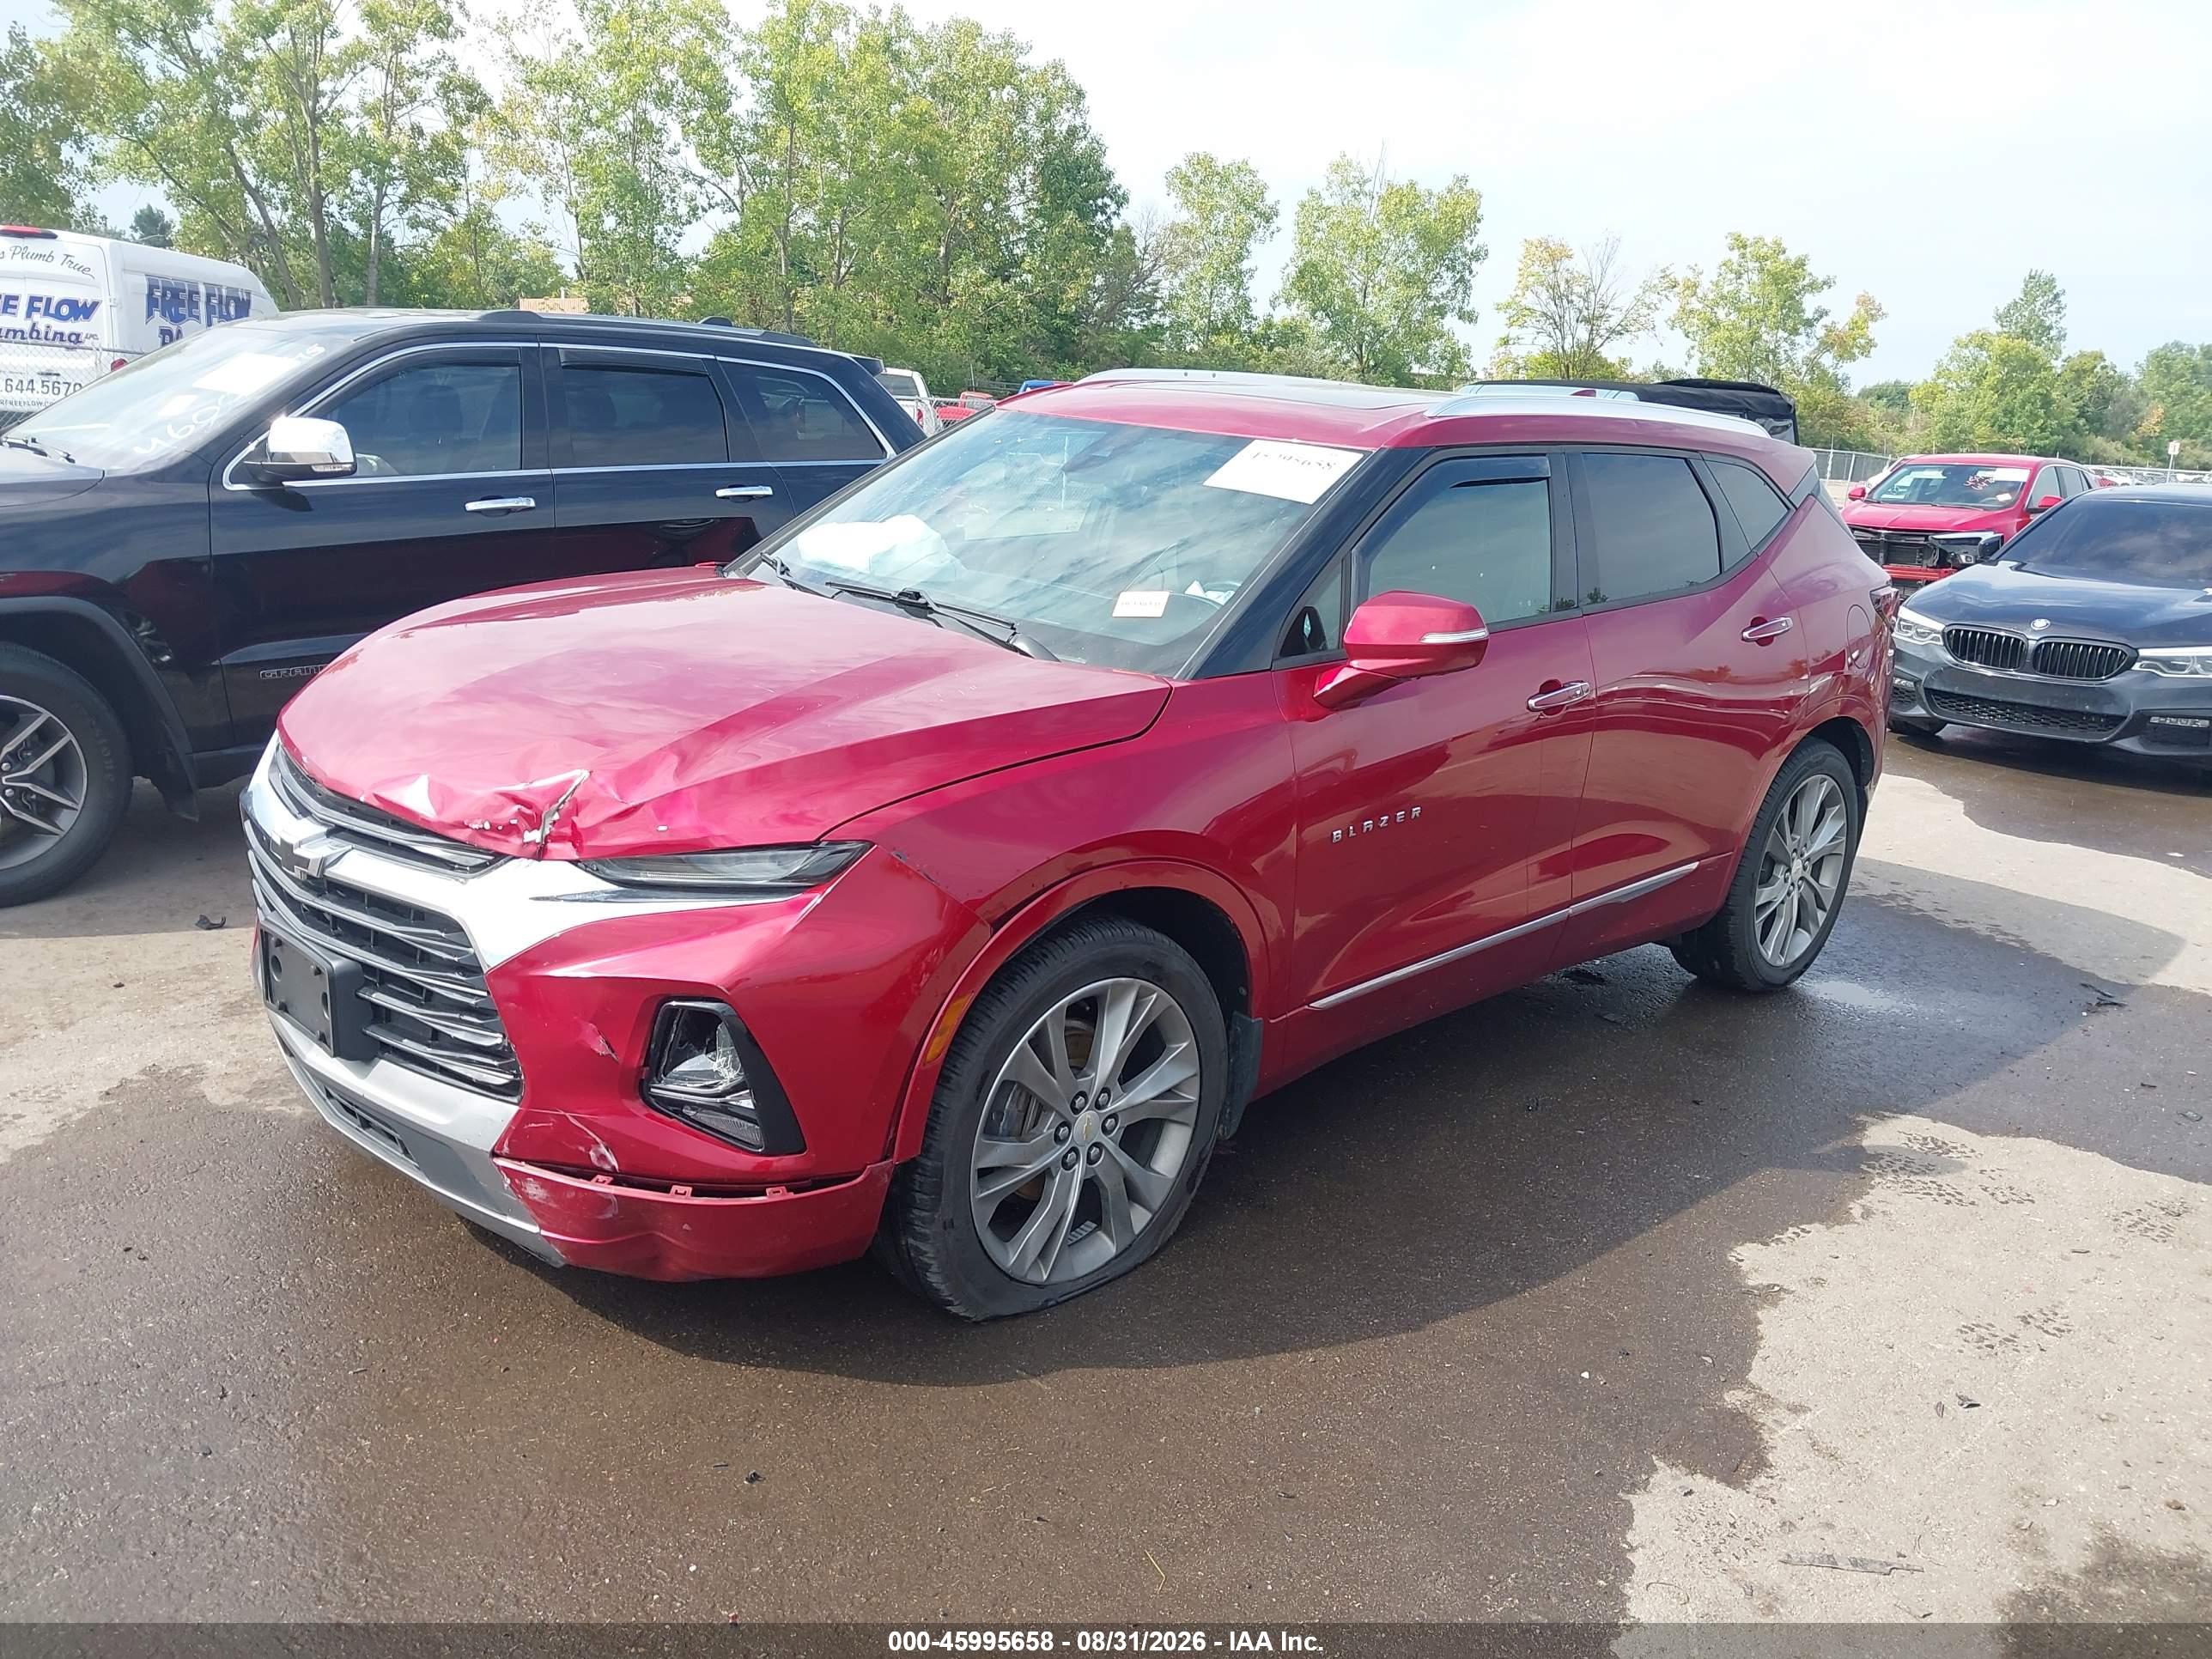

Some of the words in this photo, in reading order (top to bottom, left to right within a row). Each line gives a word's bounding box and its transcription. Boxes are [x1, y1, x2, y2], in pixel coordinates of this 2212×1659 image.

[9, 246, 55, 263] Plumb
[60, 254, 95, 279] True
[24, 294, 102, 323] FLOW
[144, 274, 202, 325] FREE
[1332, 806, 1421, 842] BLAZER
